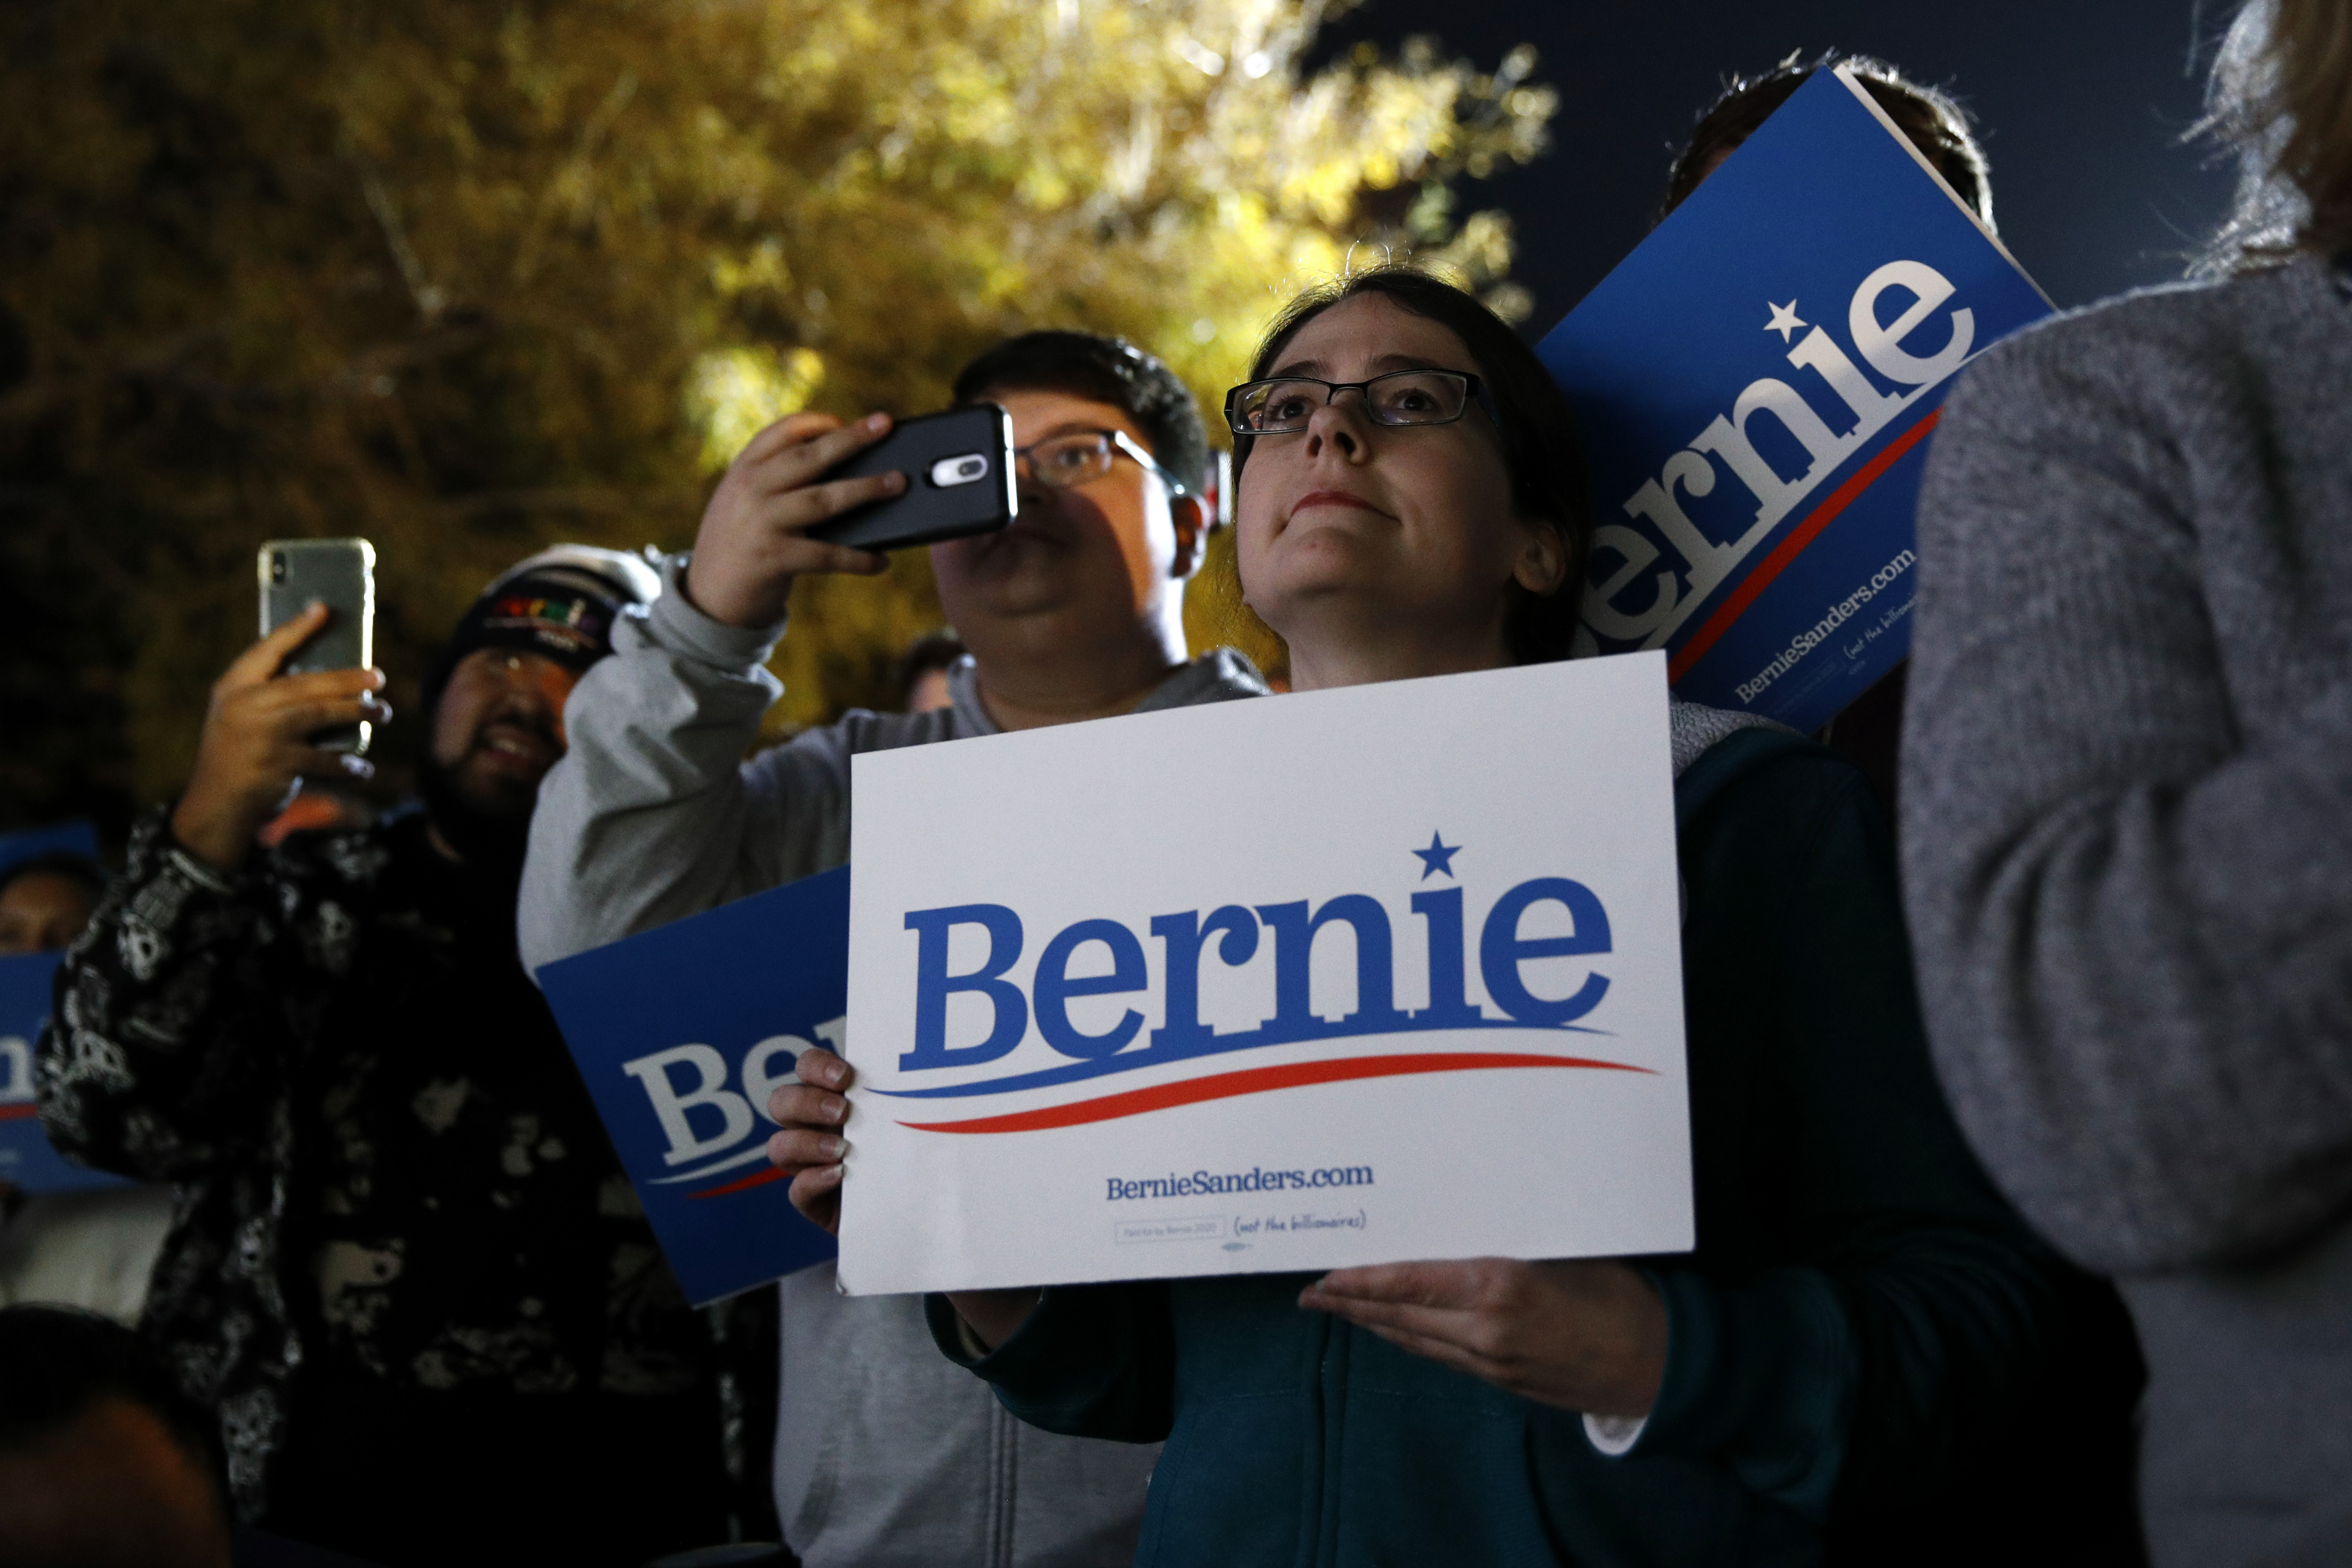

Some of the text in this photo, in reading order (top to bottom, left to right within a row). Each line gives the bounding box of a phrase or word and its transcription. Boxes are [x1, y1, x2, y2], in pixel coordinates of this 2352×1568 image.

[1735, 548, 1917, 704] BernieSanders.com
[899, 829, 1613, 1071] Bernie
[1107, 1165, 1374, 1200] BernieSanders.com
[1234, 1208, 1367, 1237] (not the billionaires)
